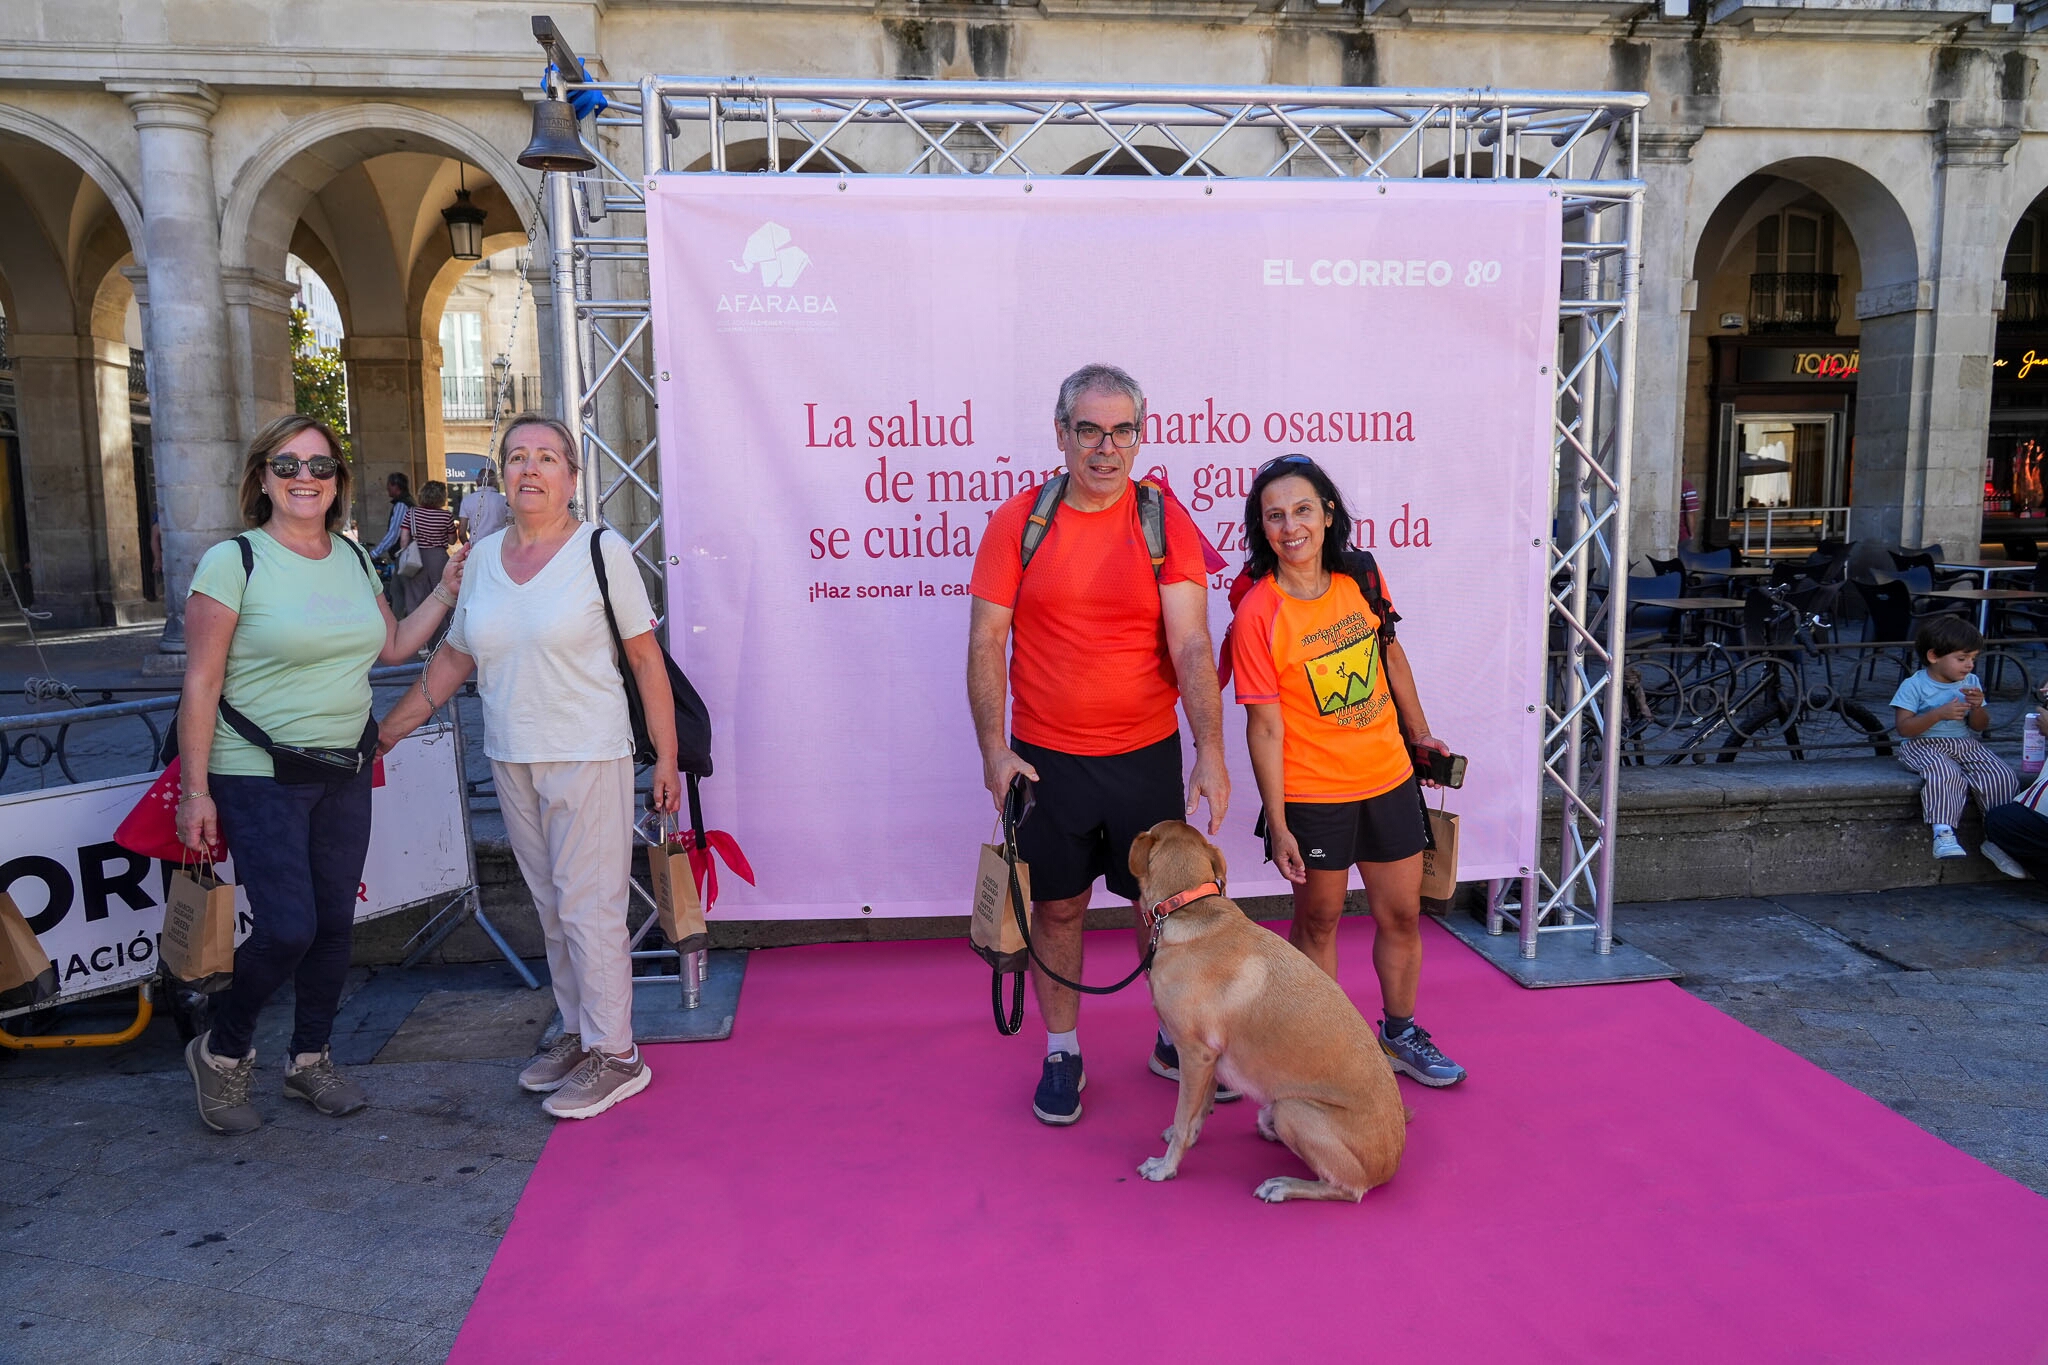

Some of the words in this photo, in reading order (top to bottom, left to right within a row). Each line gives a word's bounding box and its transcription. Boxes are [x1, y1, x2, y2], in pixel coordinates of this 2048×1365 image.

[1263, 259, 1304, 286] EL
[1310, 259, 1453, 287] CORREO
[1464, 260, 1502, 287] 80
[716, 294, 838, 313] AFARABA
[804, 403, 856, 447] La
[868, 399, 975, 447] salud
[1140, 397, 1250, 444] harko
[1264, 410, 1415, 443] osasuna
[445, 468, 466, 478] Blue
[865, 456, 914, 503] de
[1191, 464, 1257, 512] gau
[809, 528, 850, 560] se
[864, 511, 975, 560] cuida
[1388, 503, 1432, 548] da
[809, 582, 851, 602] ¡Haz
[856, 585, 913, 598] sonar
[918, 581, 936, 597] la
